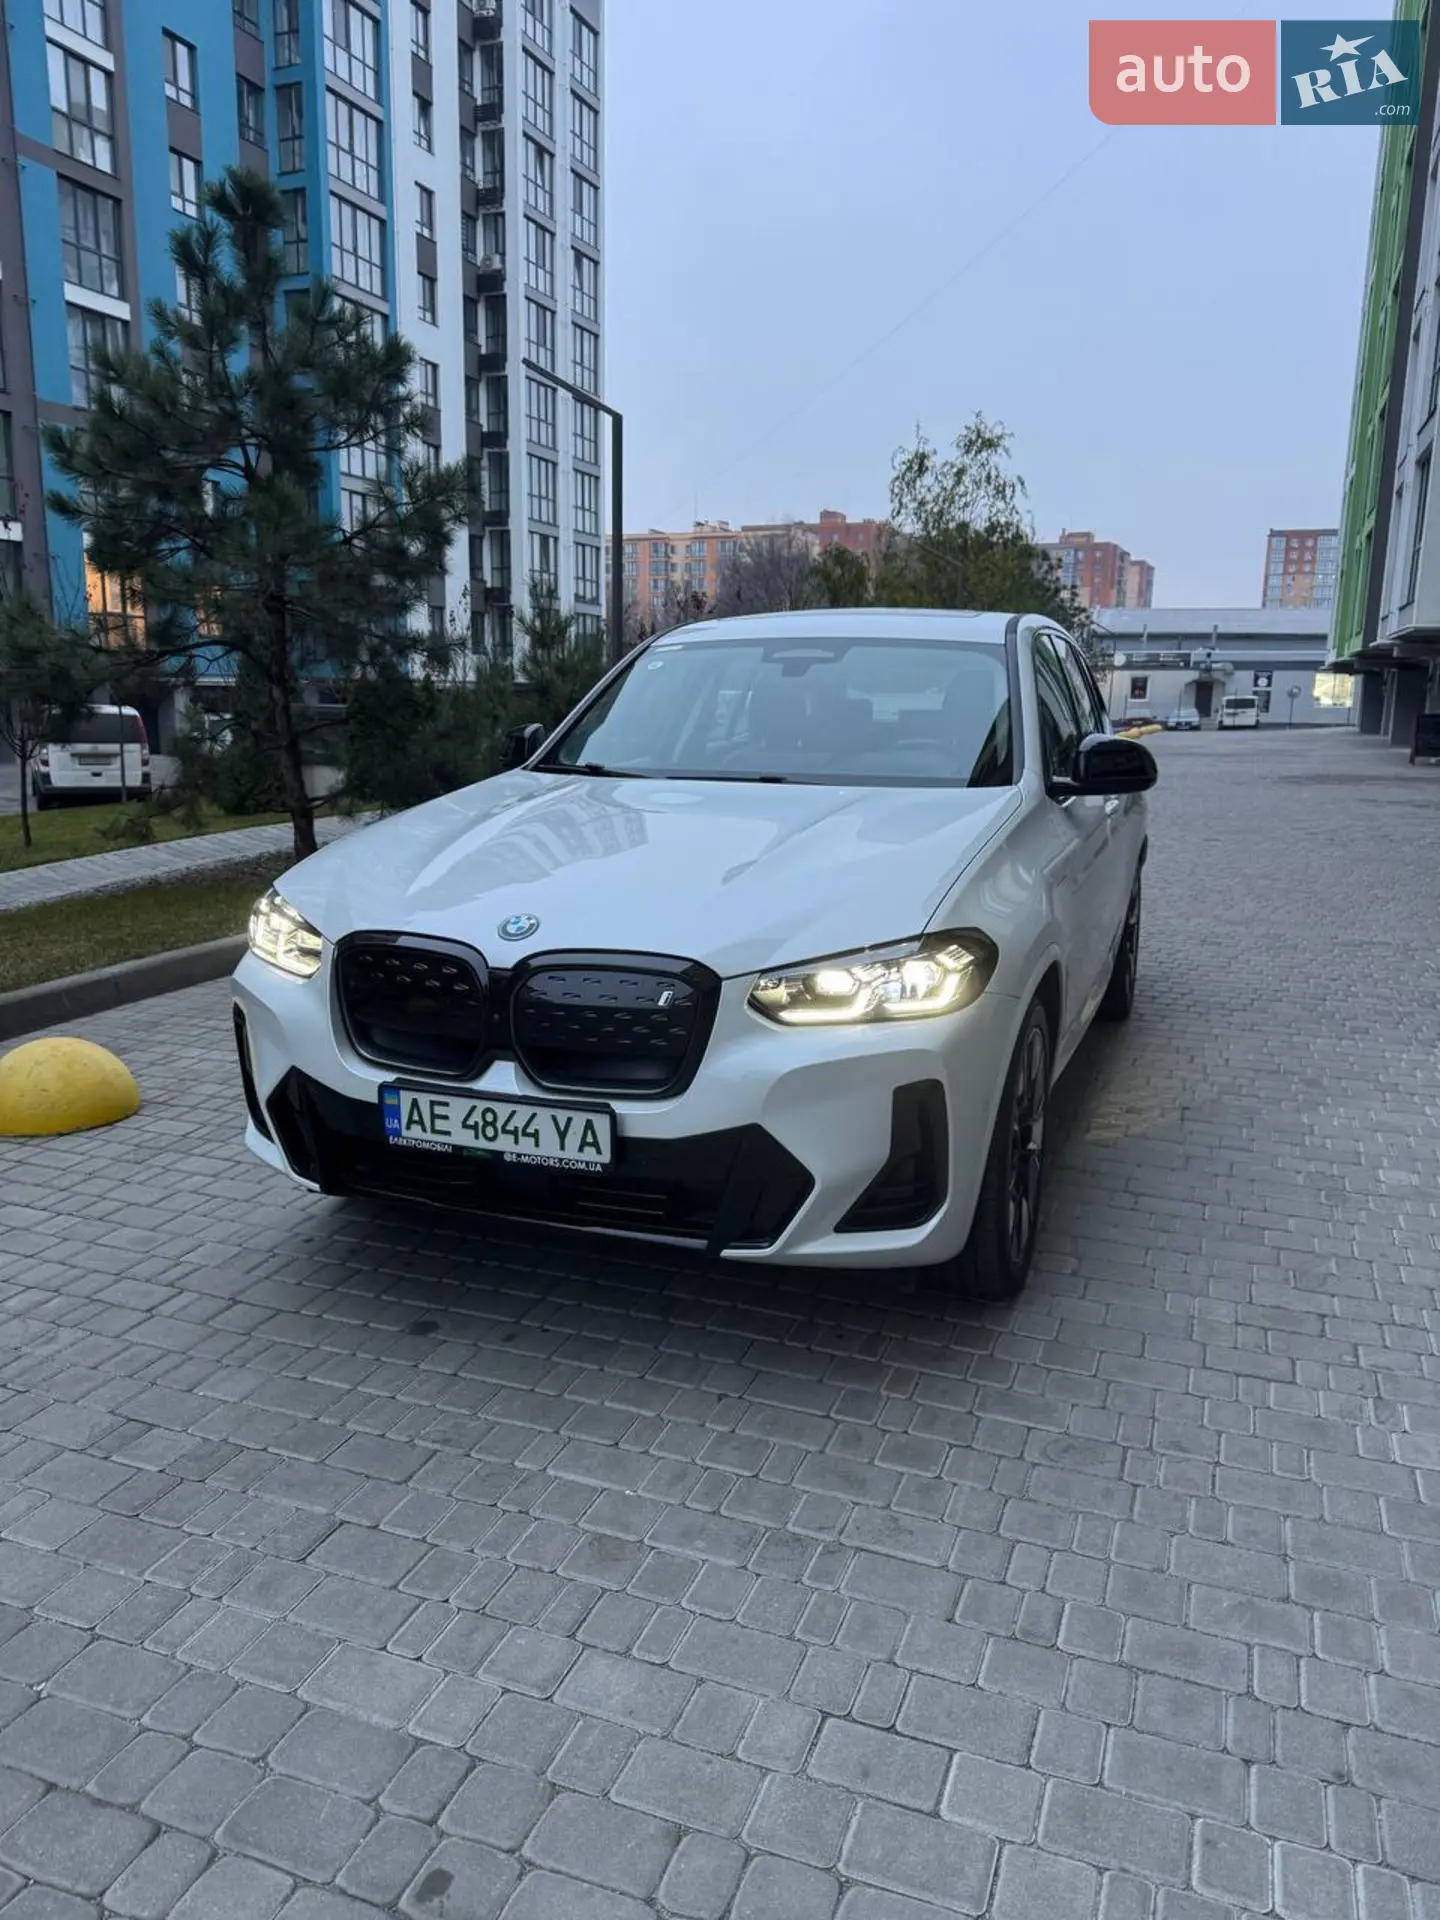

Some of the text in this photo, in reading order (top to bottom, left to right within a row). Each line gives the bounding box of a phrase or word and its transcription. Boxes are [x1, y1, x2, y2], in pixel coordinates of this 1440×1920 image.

[385, 1117, 400, 1129] UA
[404, 1097, 603, 1156] AE 4844 YA
